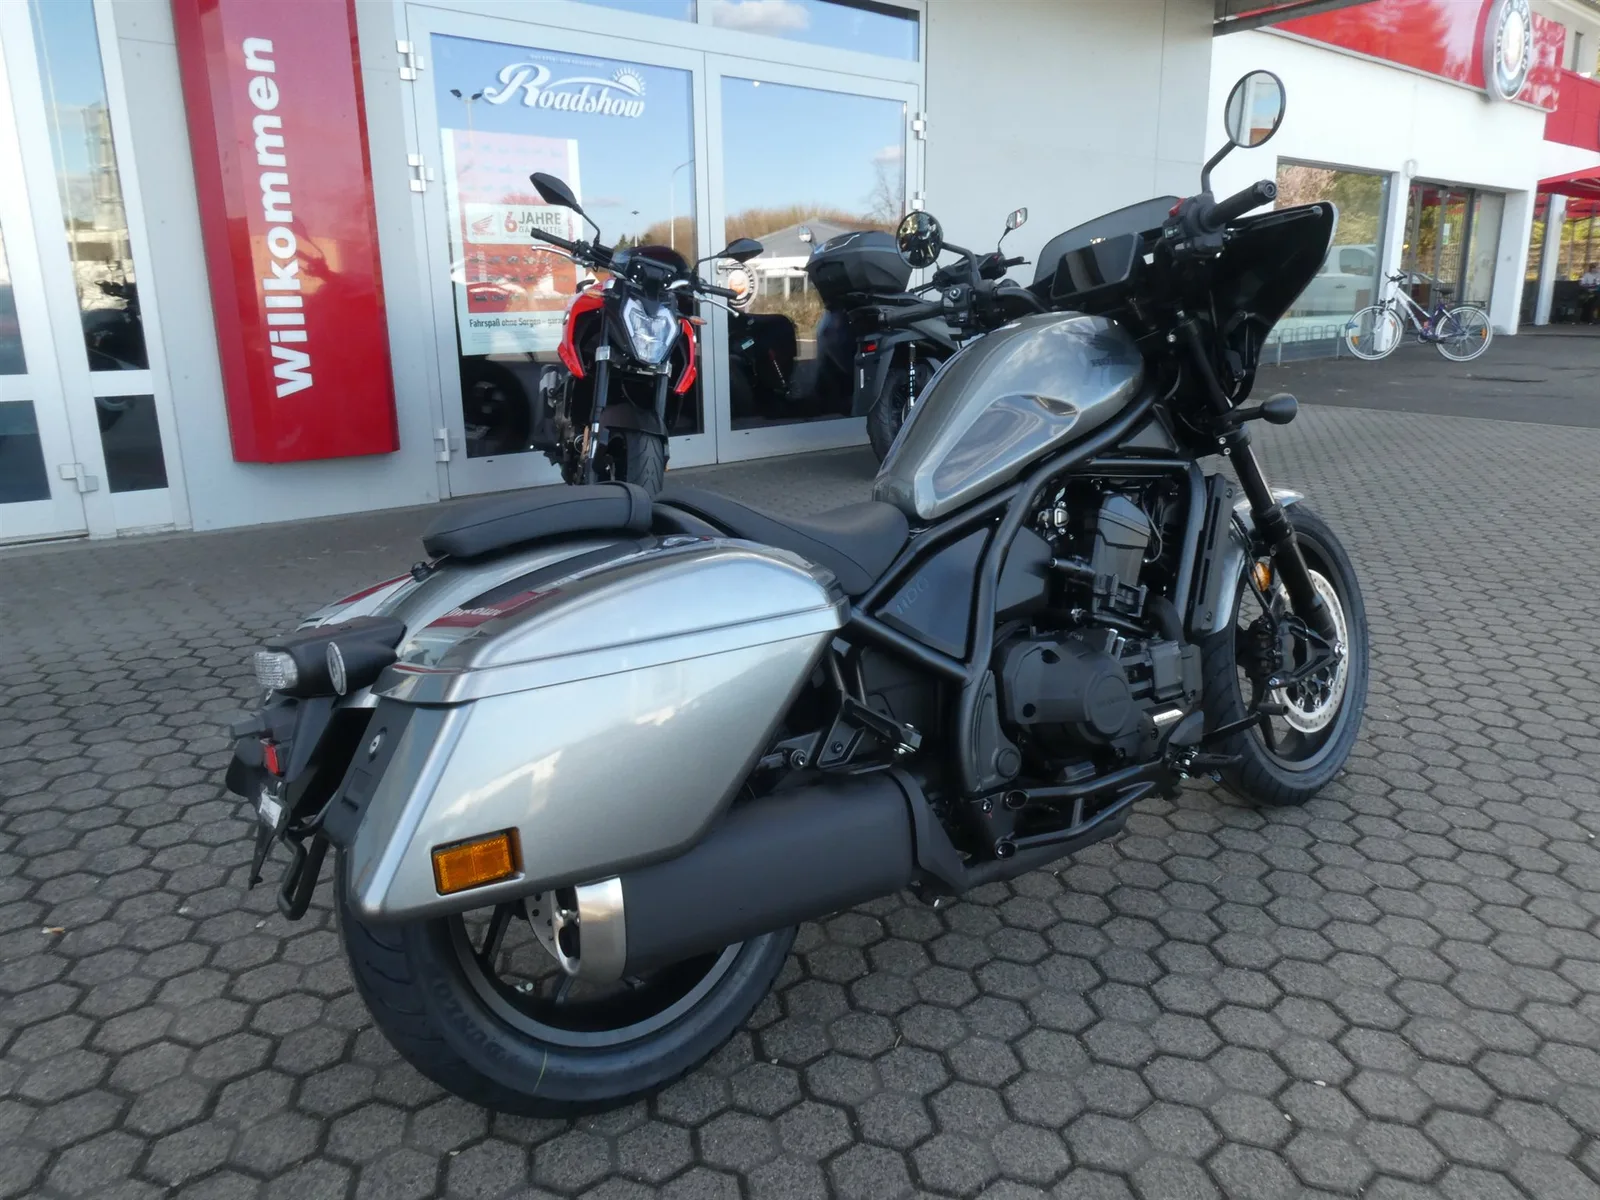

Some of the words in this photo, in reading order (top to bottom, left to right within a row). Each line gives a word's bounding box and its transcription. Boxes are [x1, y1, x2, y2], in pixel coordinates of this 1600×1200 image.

[483, 62, 645, 118] Roadshow
[242, 36, 314, 399] Willkommen
[504, 211, 518, 233] 6
[518, 211, 561, 225] JAHRE
[518, 225, 563, 234] GANTIE
[469, 317, 501, 329] Fahrspaß
